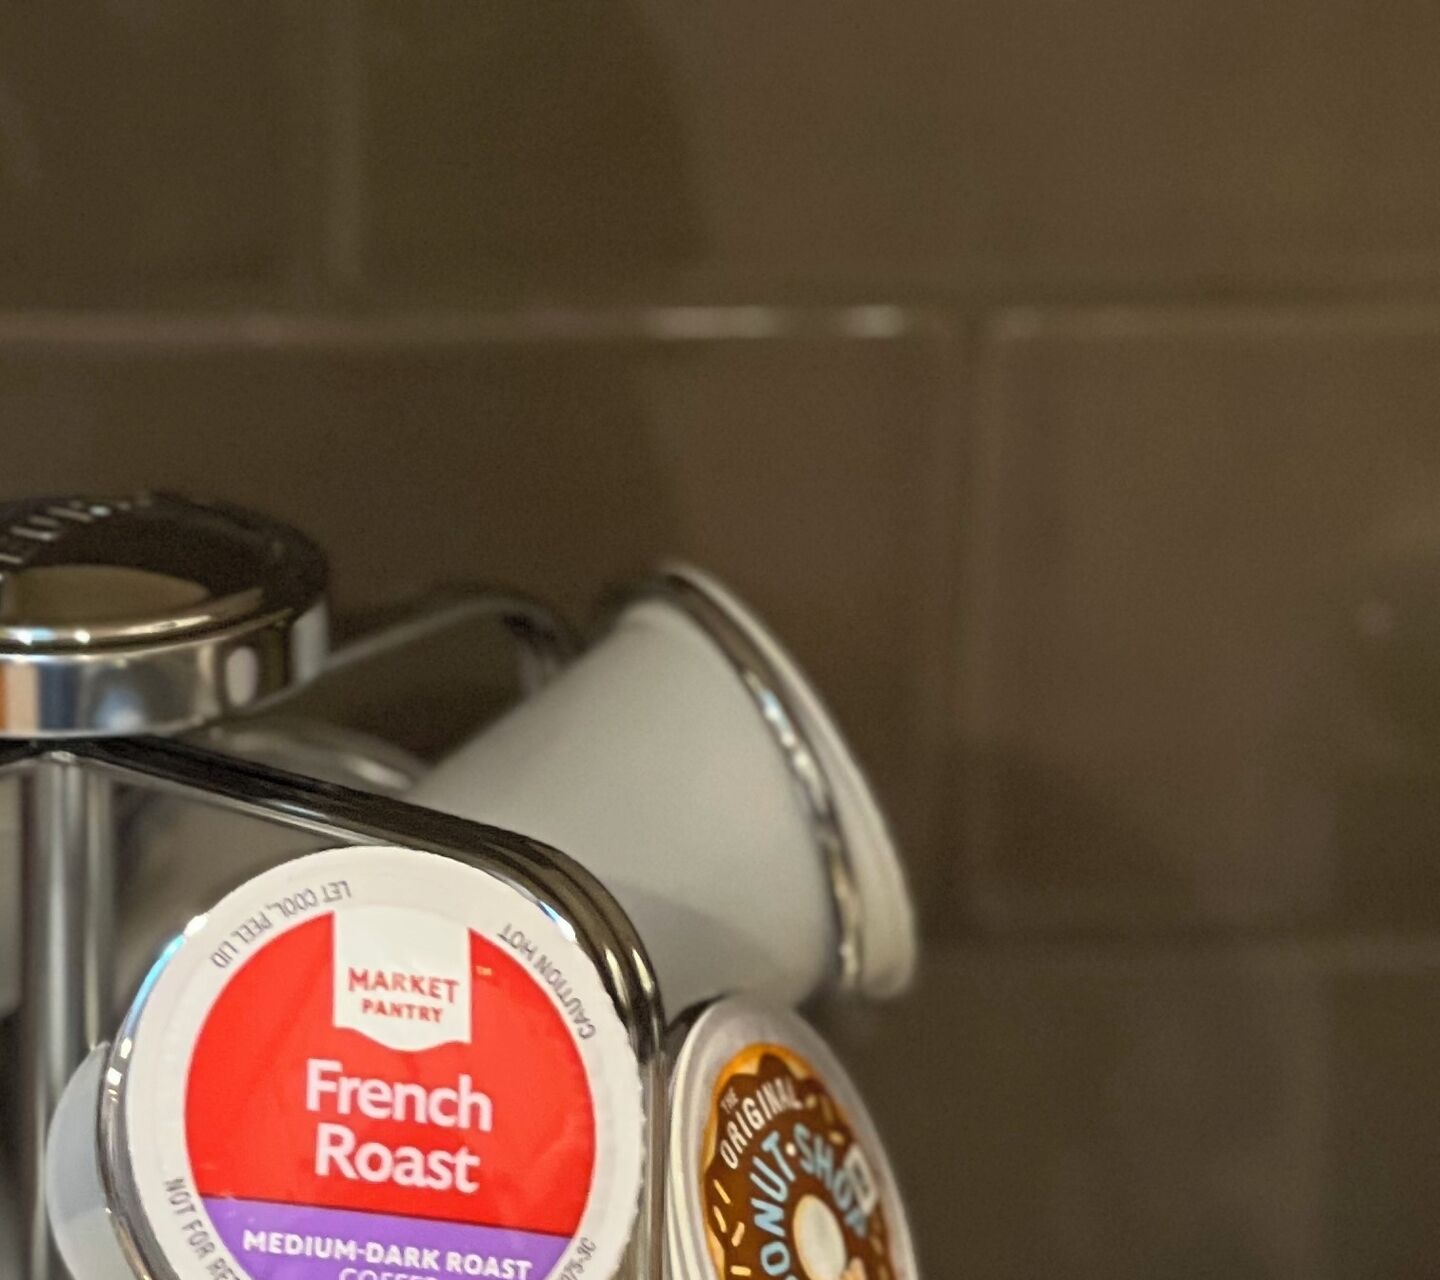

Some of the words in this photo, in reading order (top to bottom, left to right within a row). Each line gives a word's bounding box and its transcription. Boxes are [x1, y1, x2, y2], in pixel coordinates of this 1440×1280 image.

[323, 881, 352, 900] LET
[236, 915, 272, 943] PEEL
[497, 922, 535, 962] HOT
[348, 967, 460, 1004] MARKET
[533, 955, 596, 1041] CAUTION
[362, 998, 443, 1024] PANTRY
[305, 1058, 492, 1131] French
[314, 1124, 480, 1194] Roast
[164, 1178, 197, 1215] NOT
[182, 1219, 216, 1261] FOR
[242, 1229, 441, 1272] MEDIUM-DARK
